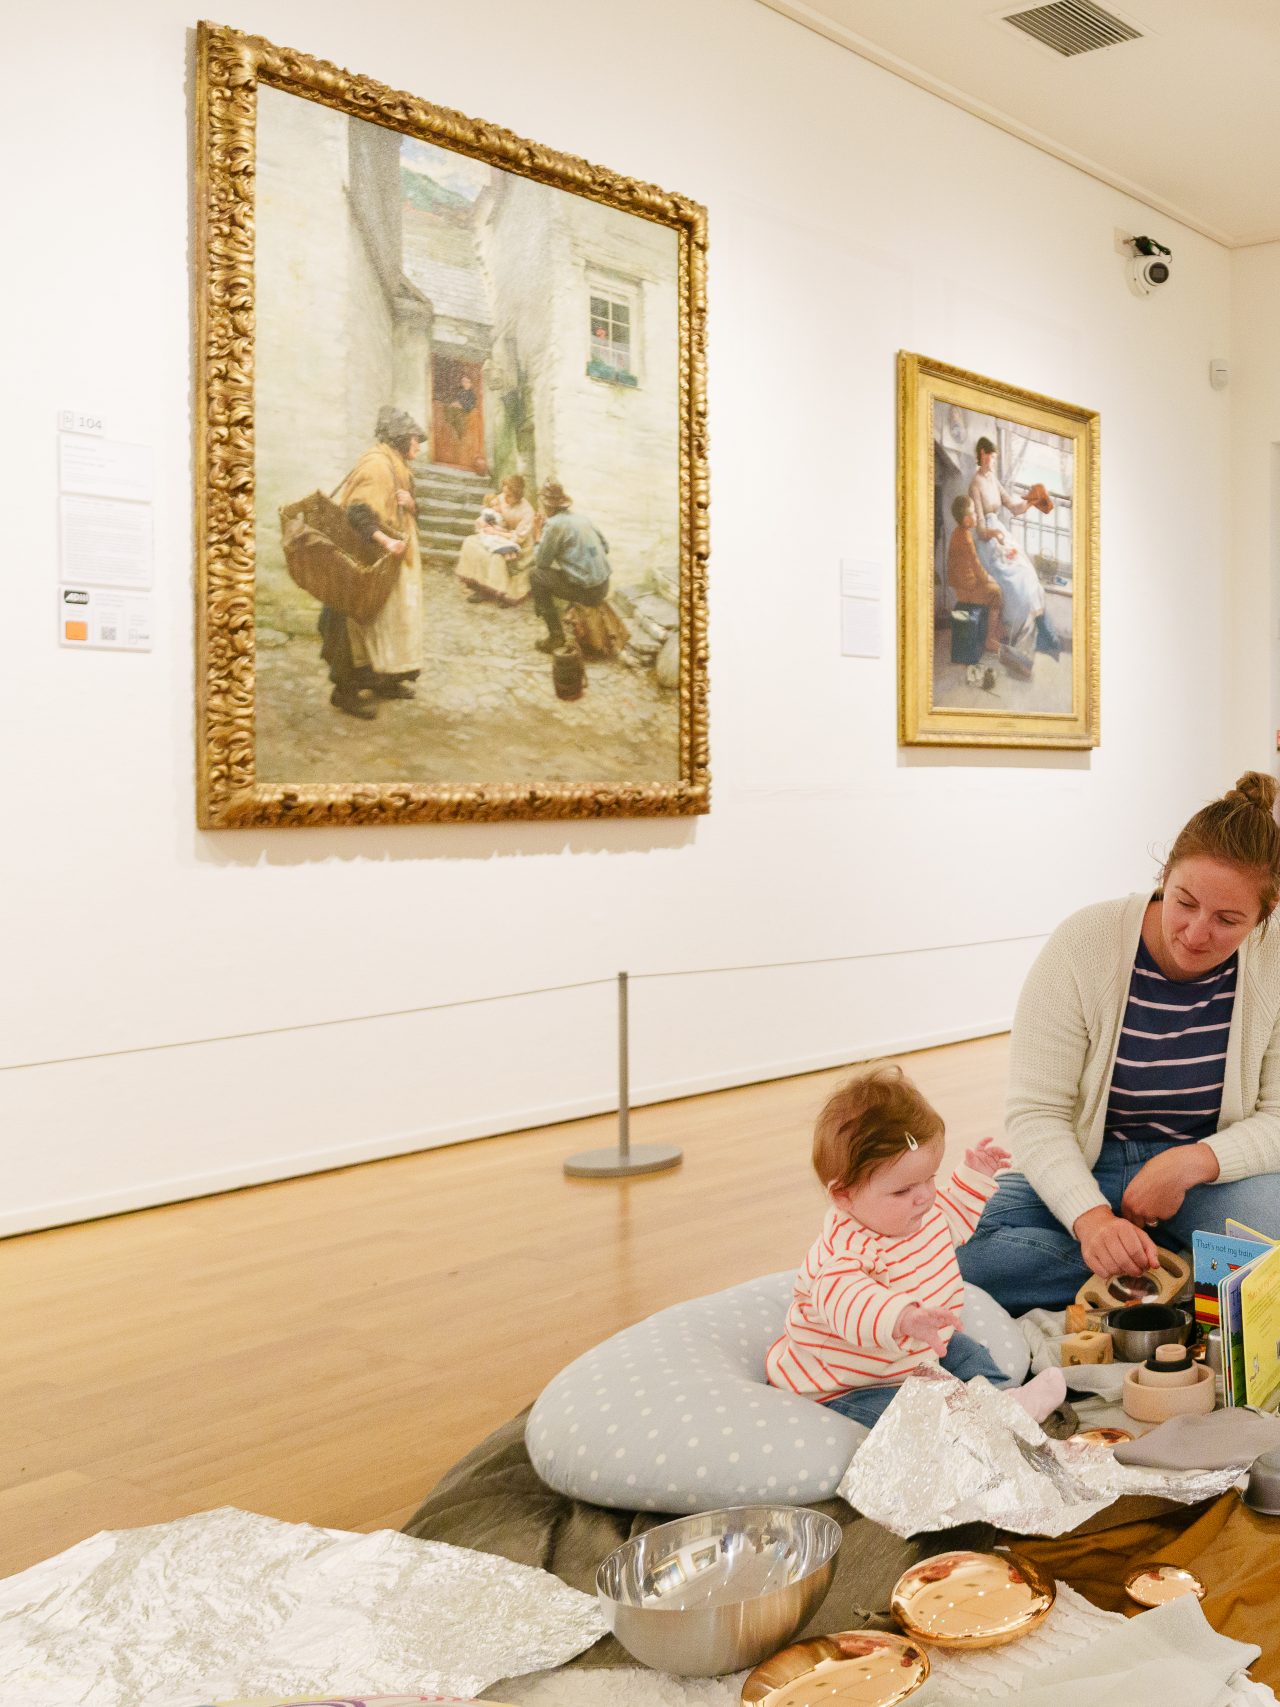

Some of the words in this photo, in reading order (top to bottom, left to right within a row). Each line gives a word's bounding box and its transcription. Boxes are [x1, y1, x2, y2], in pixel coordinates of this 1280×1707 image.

[1196, 1239, 1215, 1250] That's
[1215, 1244, 1226, 1253] not
[1227, 1248, 1237, 1258] my
